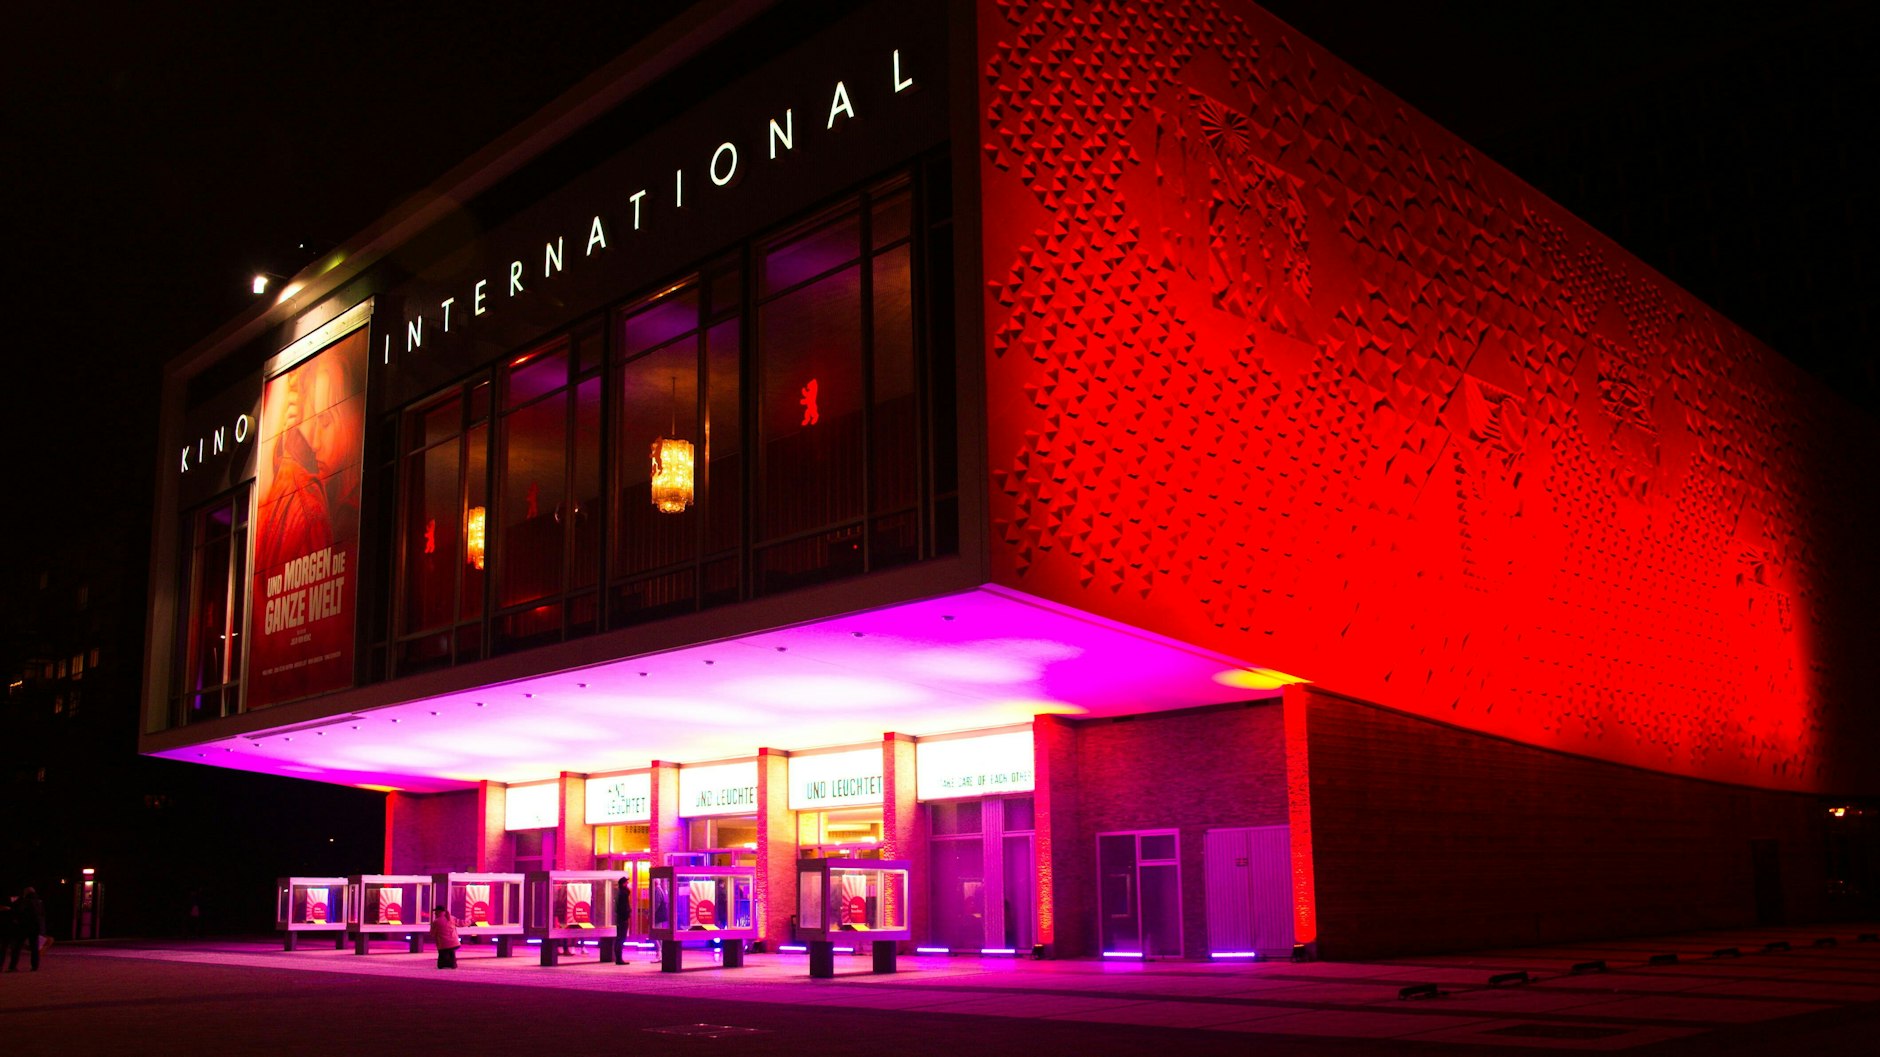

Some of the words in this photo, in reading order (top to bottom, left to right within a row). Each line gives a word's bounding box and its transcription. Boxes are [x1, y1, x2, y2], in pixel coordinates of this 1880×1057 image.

[180, 413, 248, 474] KINO
[383, 48, 913, 365] INTERNATIONAL
[267, 574, 283, 598] UND
[284, 547, 332, 592] MORGEN
[332, 551, 346, 576] DIE
[264, 589, 306, 635] GANZE
[308, 576, 345, 622] WELT
[717, 786, 758, 806] LEUCHTE
[806, 780, 826, 800] UND
[832, 776, 882, 798] LEUCHTET
[978, 774, 986, 786] OF
